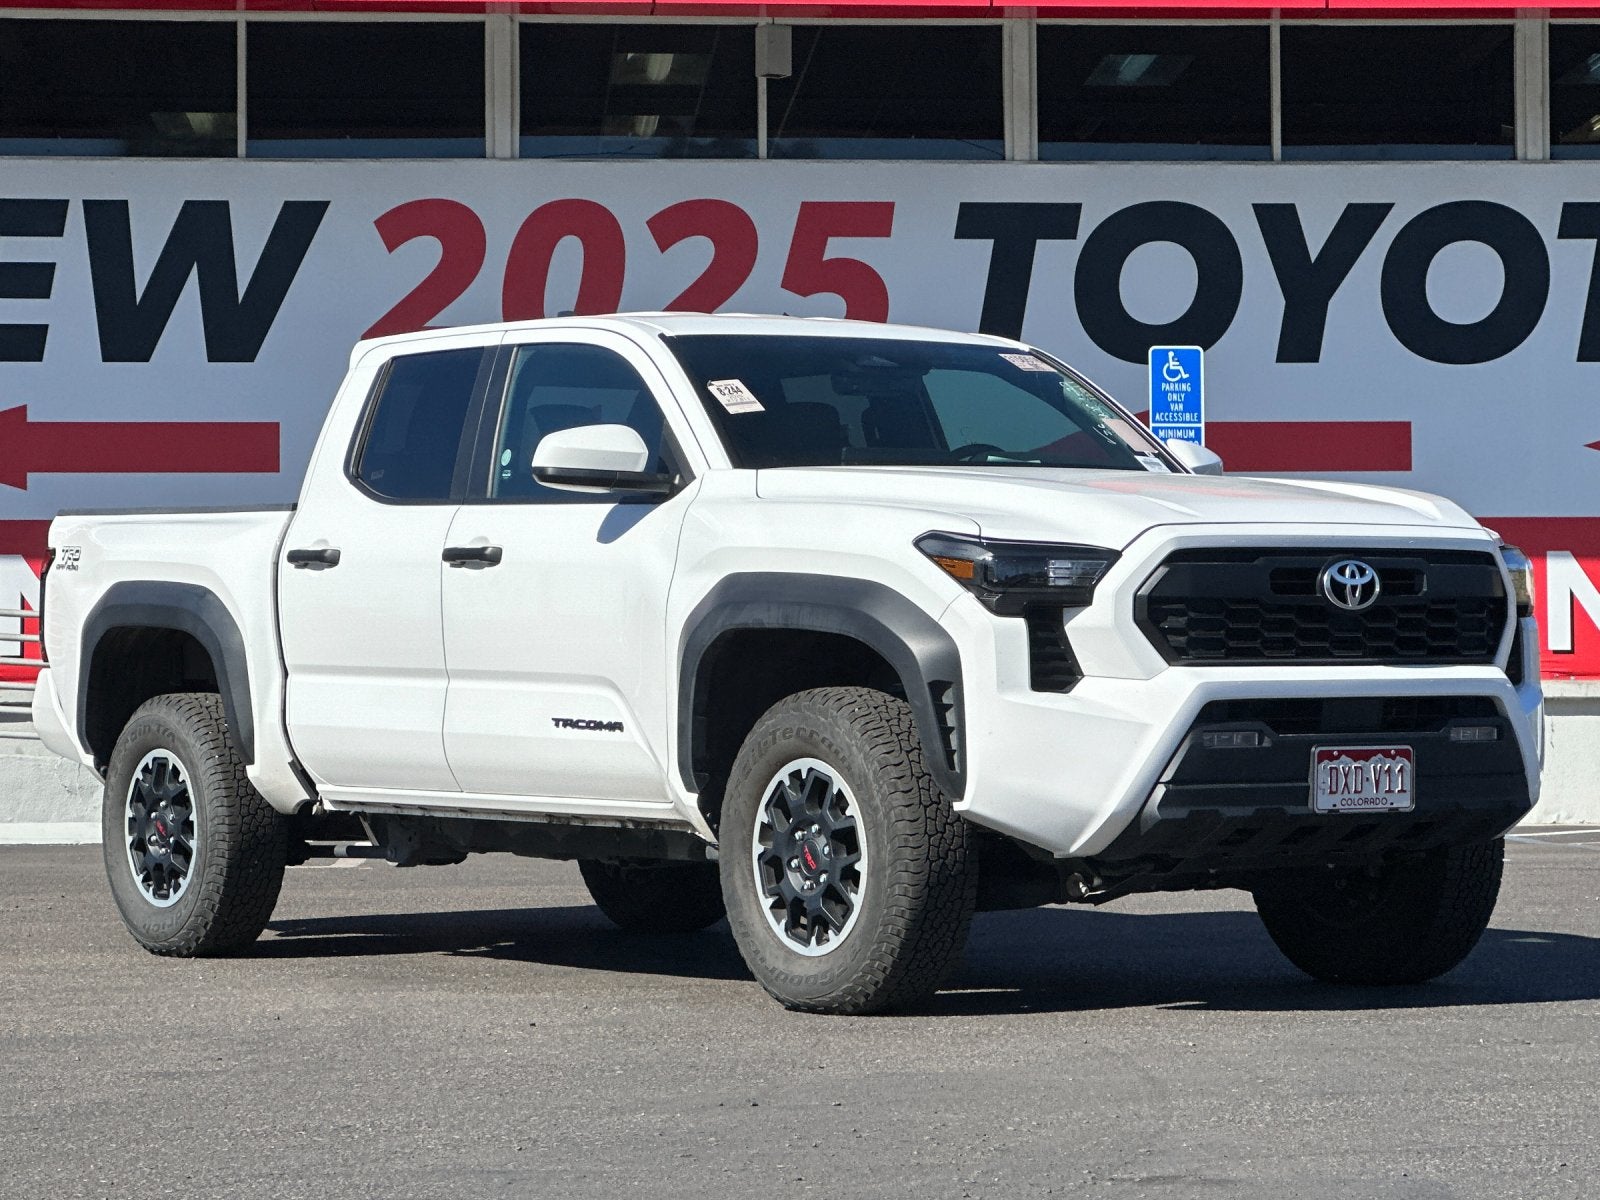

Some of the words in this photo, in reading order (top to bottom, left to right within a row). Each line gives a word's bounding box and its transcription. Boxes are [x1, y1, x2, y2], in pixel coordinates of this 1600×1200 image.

[361, 198, 895, 339] 2025
[1161, 382, 1191, 391] PARKING
[1167, 393, 1185, 402] ONLY
[1170, 403, 1183, 411] VAN
[1155, 412, 1199, 421] ACCESSIBLE
[1158, 429, 1195, 438] MINIMUM
[551, 717, 624, 732] TACOMA
[1340, 797, 1388, 806] COLORADO
